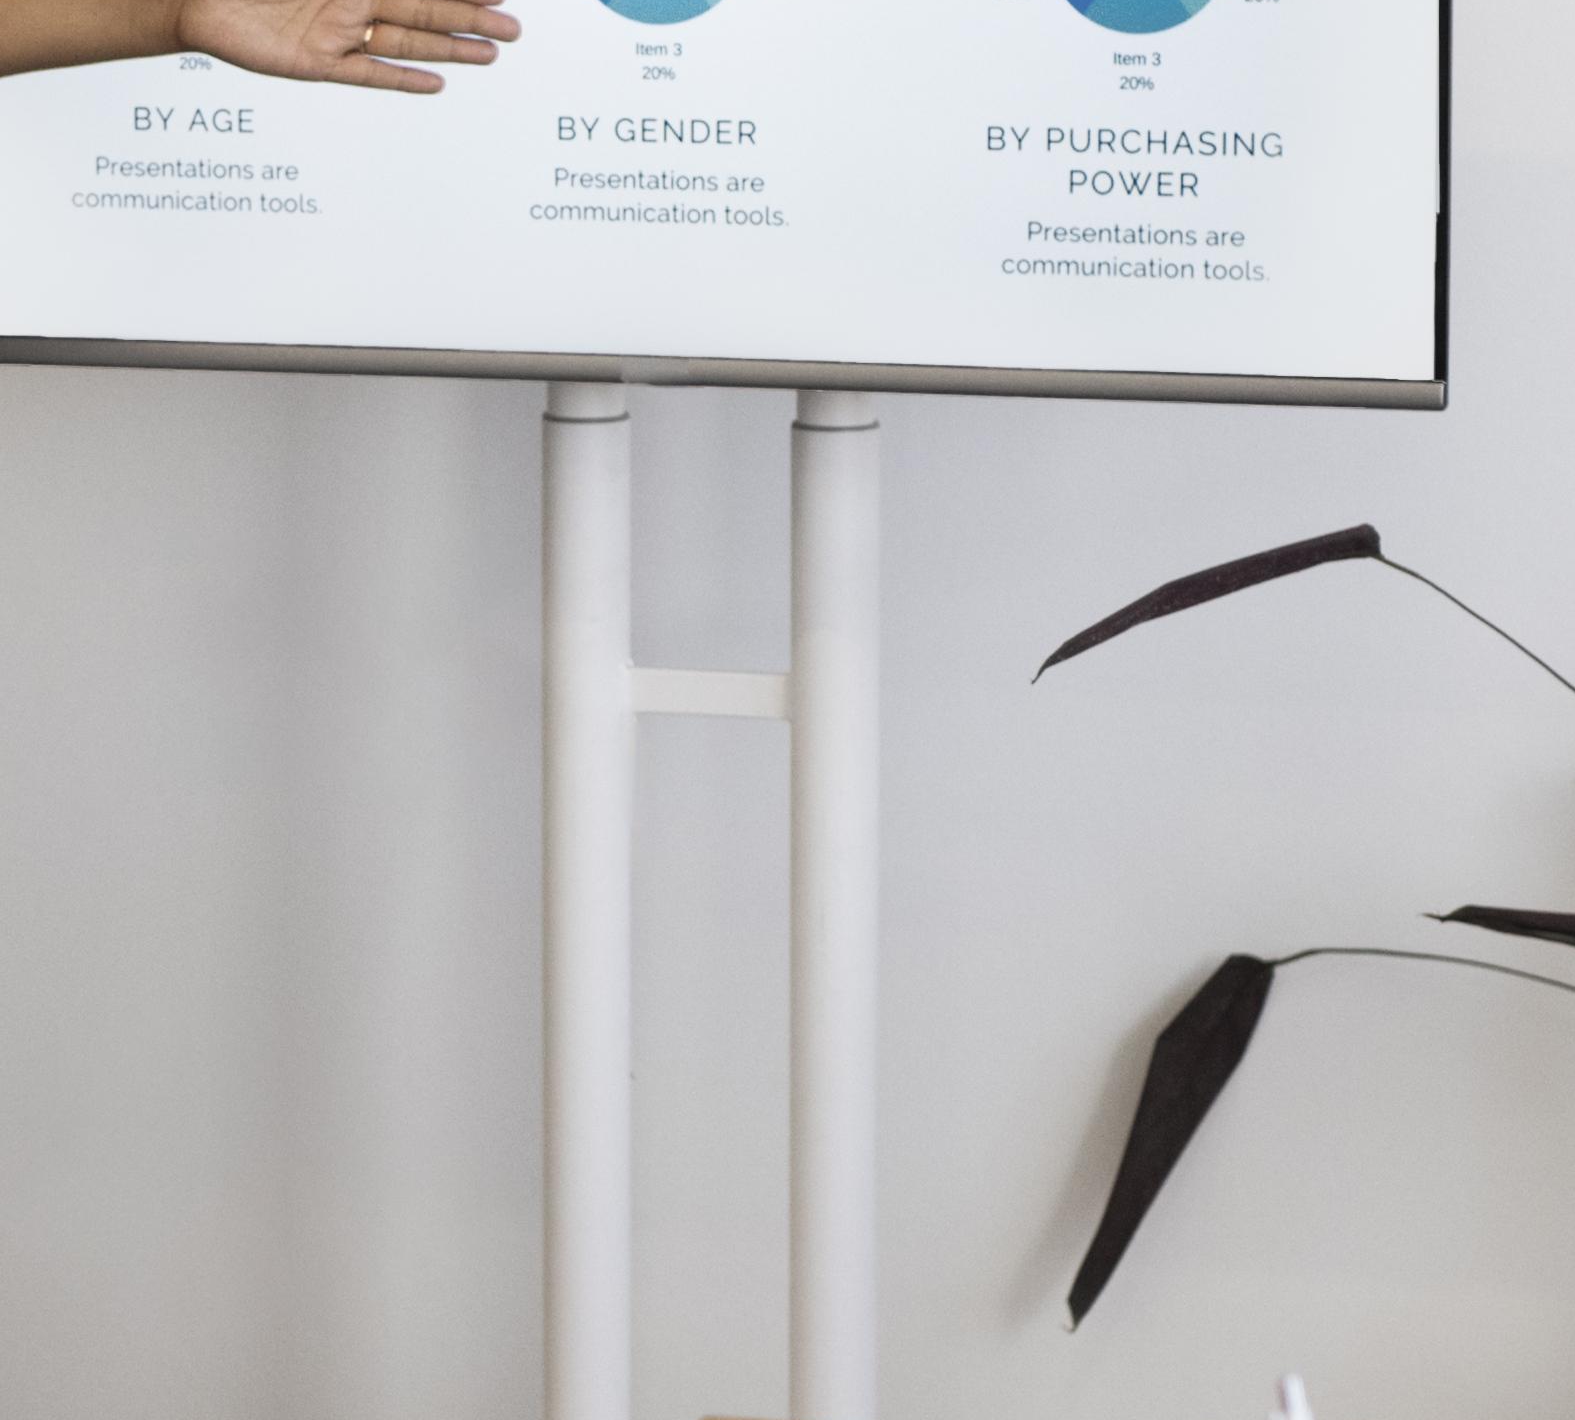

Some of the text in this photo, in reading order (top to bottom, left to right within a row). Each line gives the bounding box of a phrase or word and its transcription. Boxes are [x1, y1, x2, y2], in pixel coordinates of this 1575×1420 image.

[634, 41, 684, 58] Item 3
[1112, 51, 1163, 68] Item 3
[179, 57, 212, 70] 20%
[641, 65, 677, 81] 20%
[1118, 75, 1156, 91] 20%
[132, 105, 254, 134] BY AGE
[556, 115, 758, 146] BY GENDER
[986, 124, 1284, 159] BY PURCHASING
[94, 154, 300, 182] Presentations are
[553, 166, 766, 194] Presentations are
[1068, 168, 1200, 198] POWER
[70, 190, 323, 215] communication tools.
[528, 202, 790, 228] communication tools.
[1026, 219, 1247, 248] Presentations are
[1000, 257, 1270, 282] communication tools.
